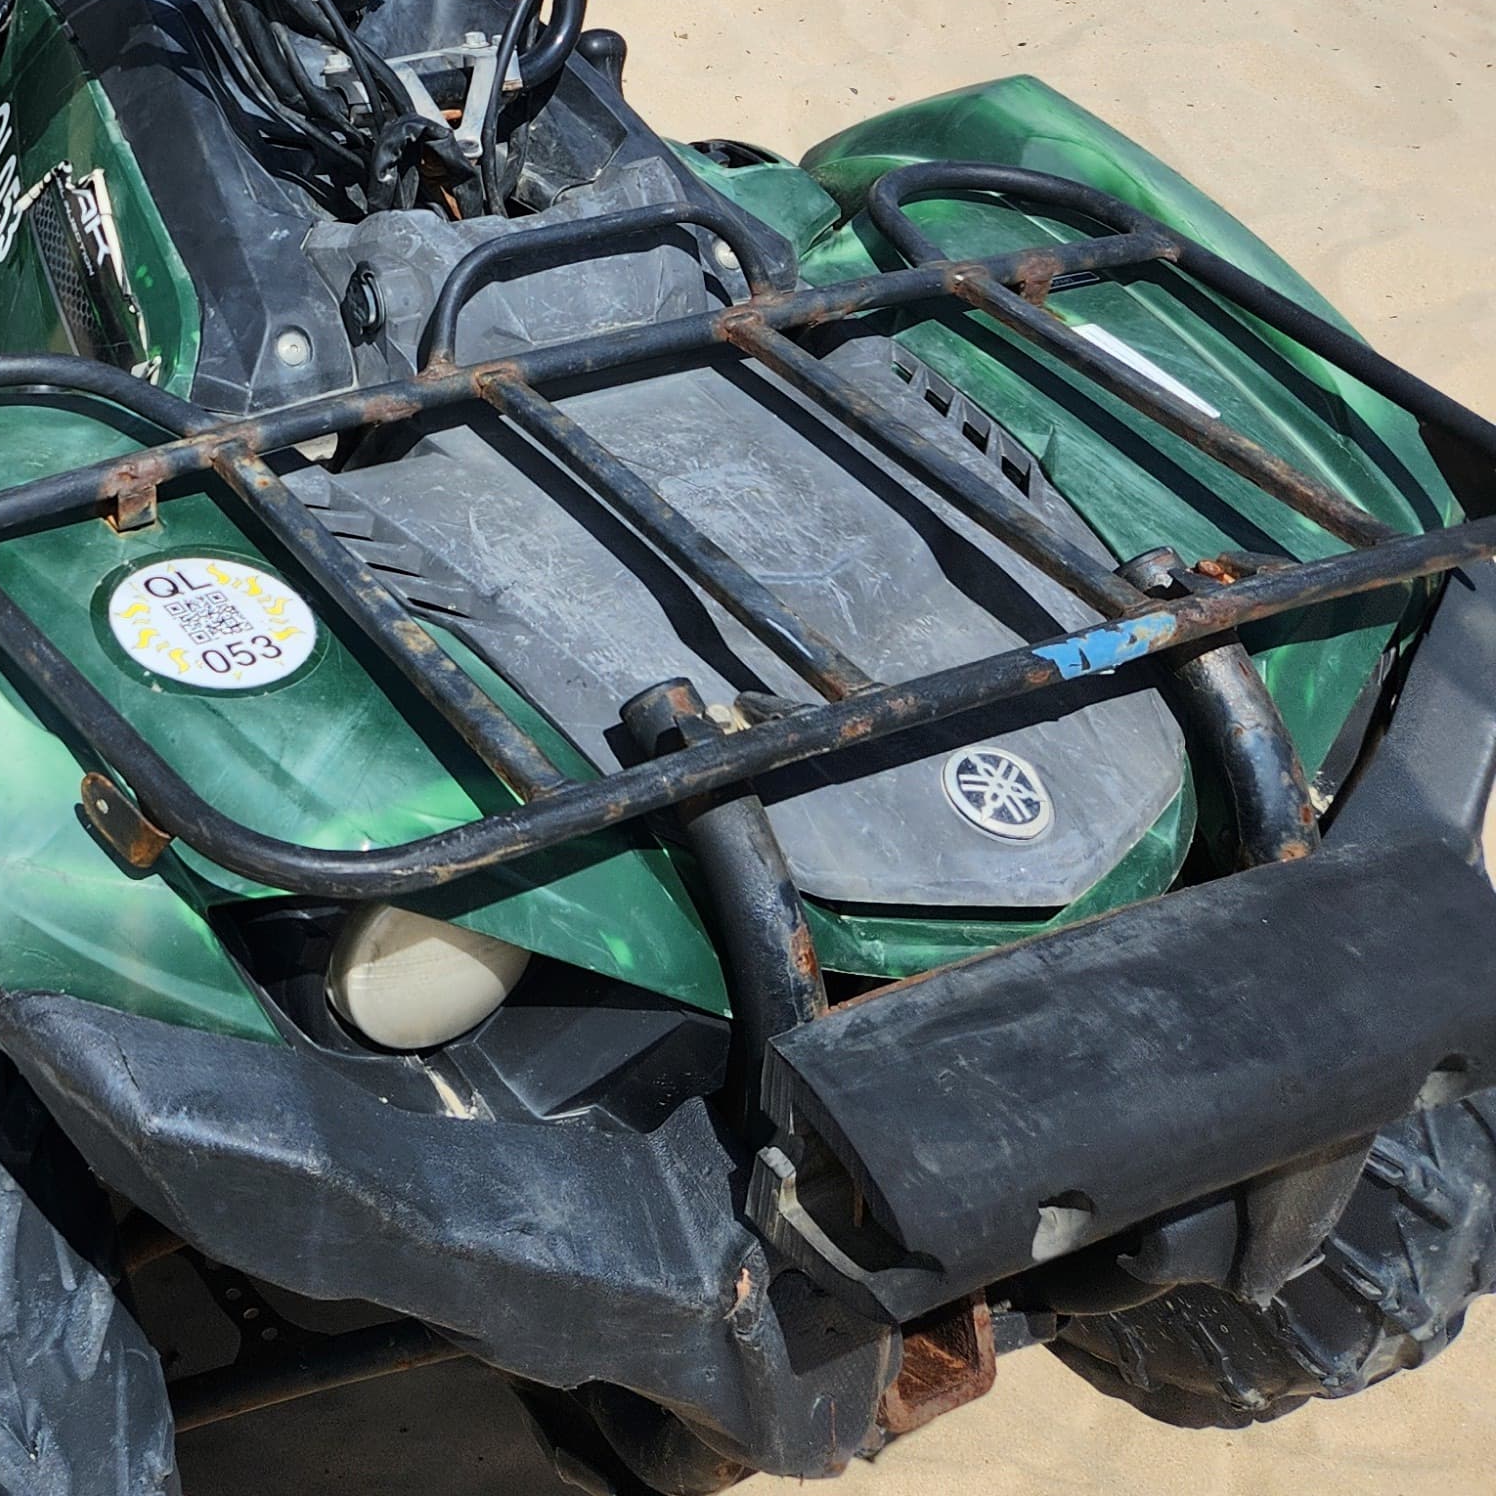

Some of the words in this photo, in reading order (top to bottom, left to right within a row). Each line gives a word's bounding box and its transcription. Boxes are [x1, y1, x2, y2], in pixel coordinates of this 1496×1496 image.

[64, 198, 96, 277] INJECTION
[143, 571, 212, 599] QL
[201, 634, 283, 674] 053
